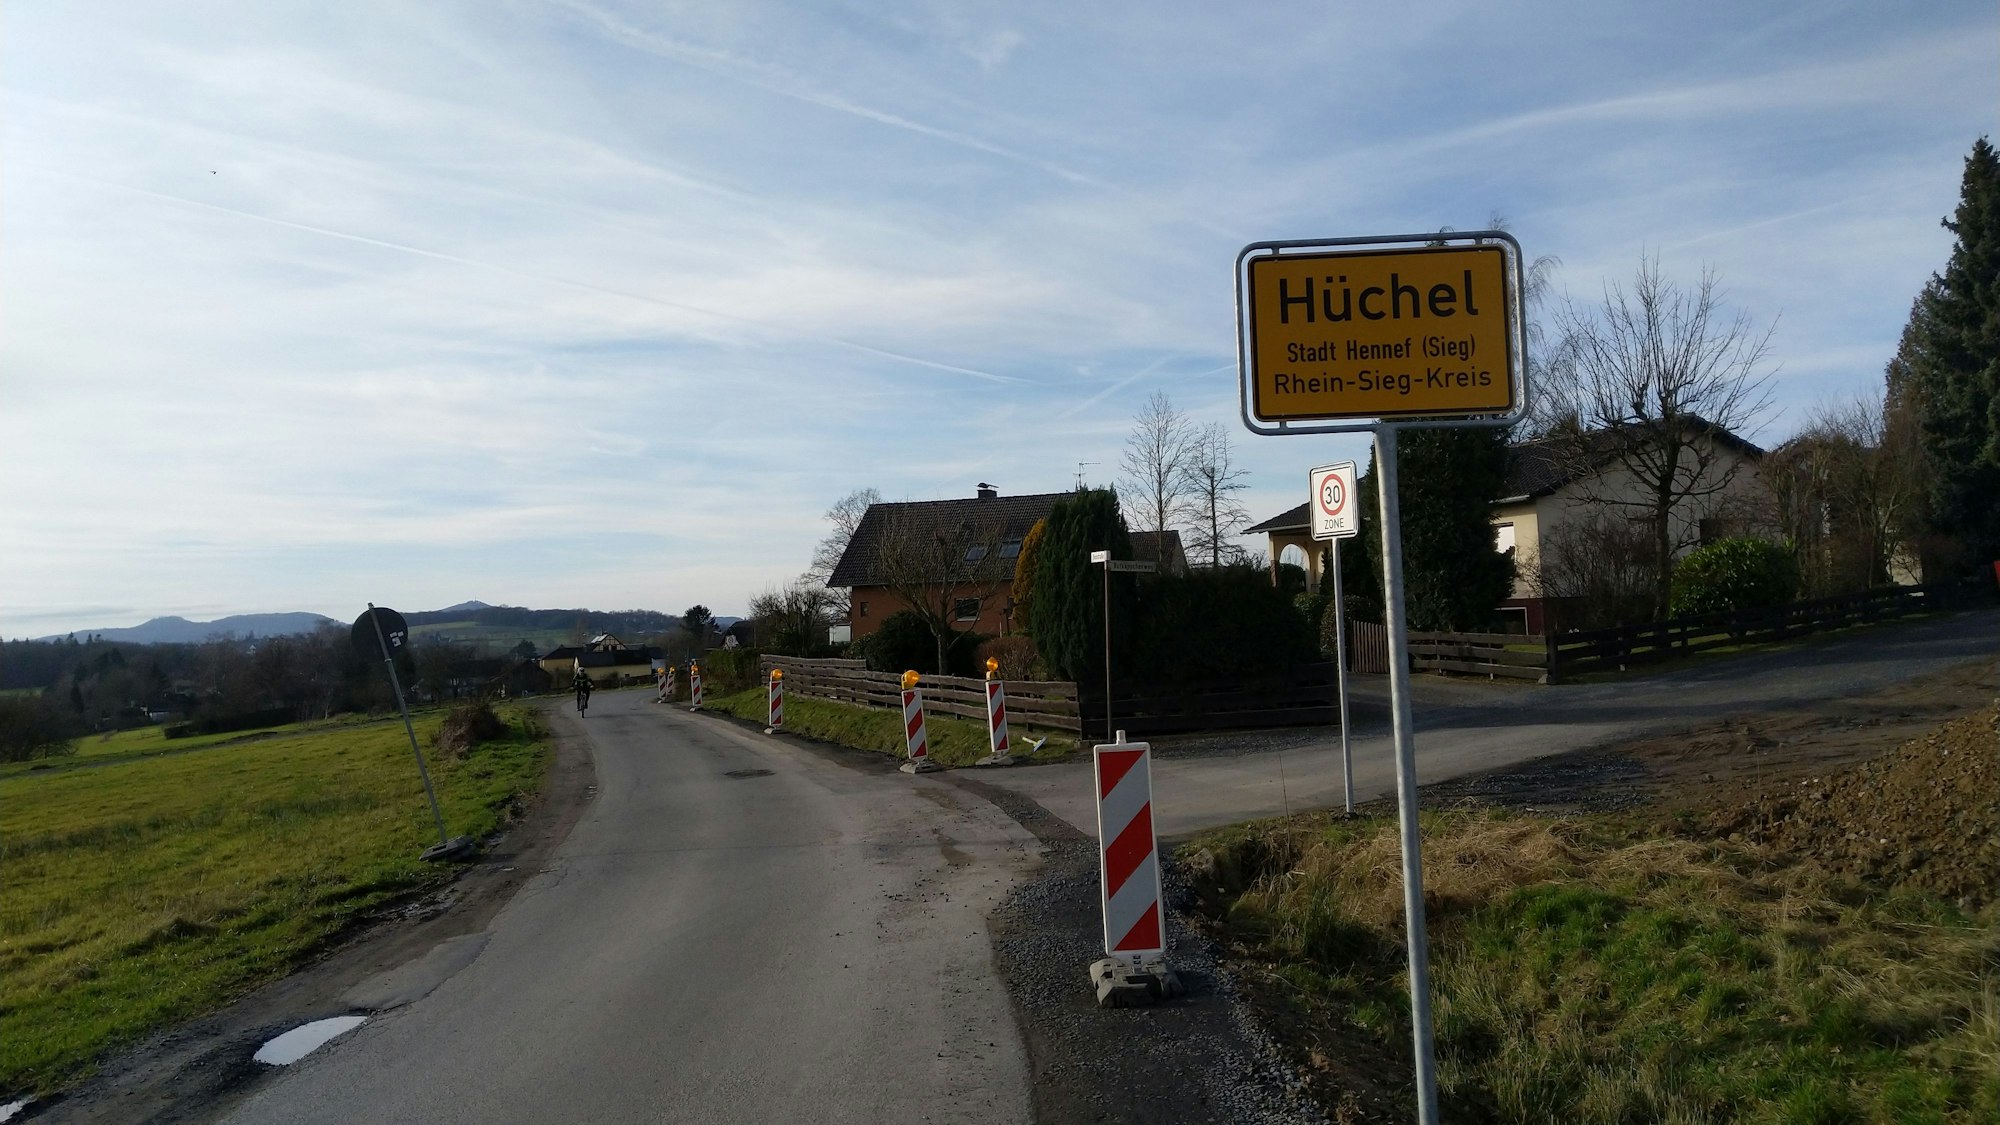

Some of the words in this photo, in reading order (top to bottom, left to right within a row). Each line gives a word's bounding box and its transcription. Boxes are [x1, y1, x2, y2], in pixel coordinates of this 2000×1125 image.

[1279, 269, 1479, 324] Hüchel
[1287, 341, 1337, 363] Stadt
[1347, 338, 1412, 361] Hennef
[1422, 334, 1476, 361] (Sieg)
[1274, 367, 1492, 395] Rhein-Sieg-Kreis
[1325, 485, 1340, 504] 30
[1324, 518, 1344, 530] ZONE
